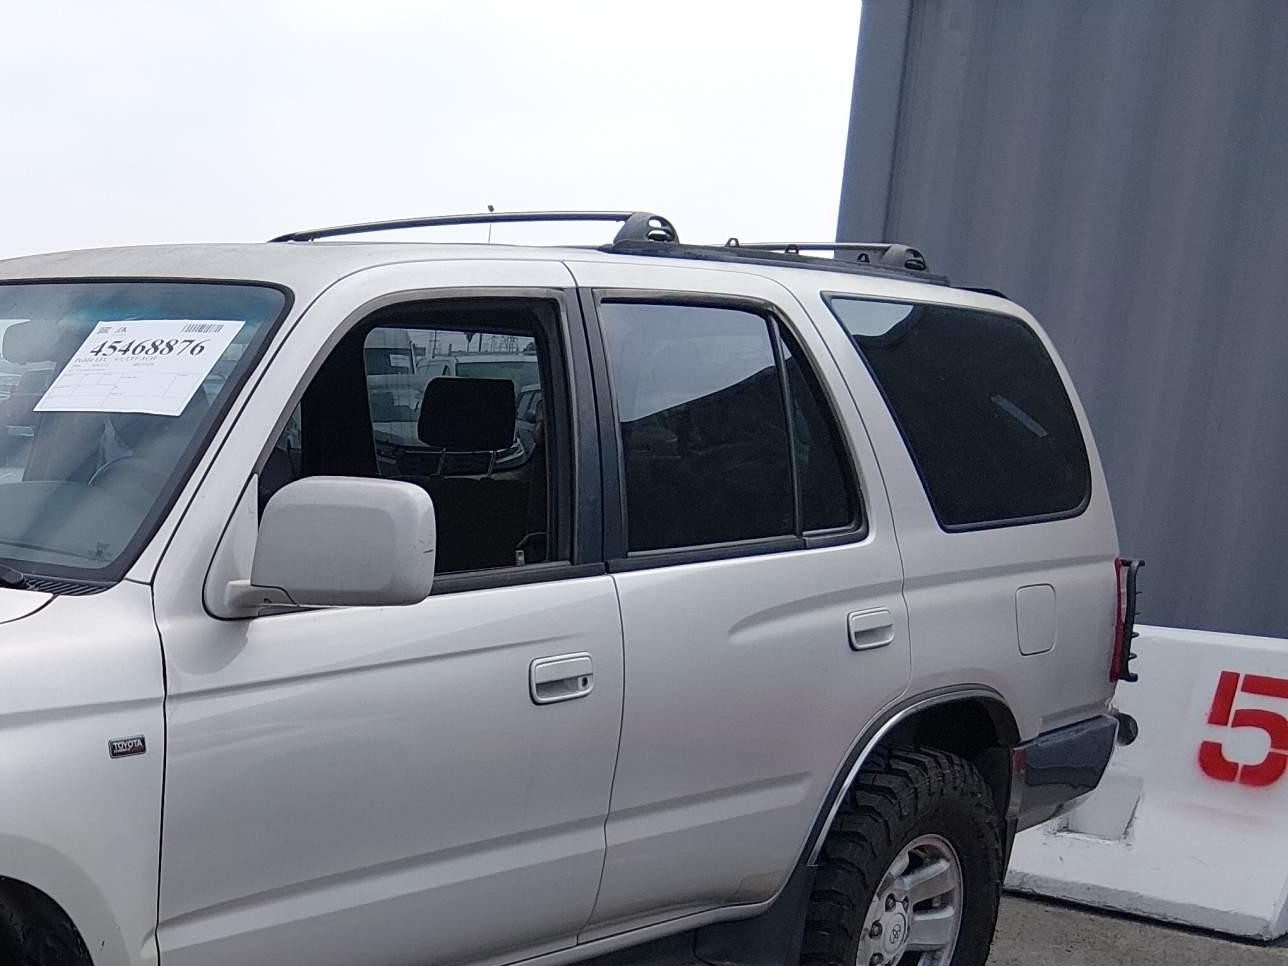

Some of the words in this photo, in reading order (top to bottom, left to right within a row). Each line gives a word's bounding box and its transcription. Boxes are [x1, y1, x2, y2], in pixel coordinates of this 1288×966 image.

[90, 338, 210, 357] 45468876
[1198, 671, 1288, 787] 5
[112, 739, 143, 750] TOYOTA
